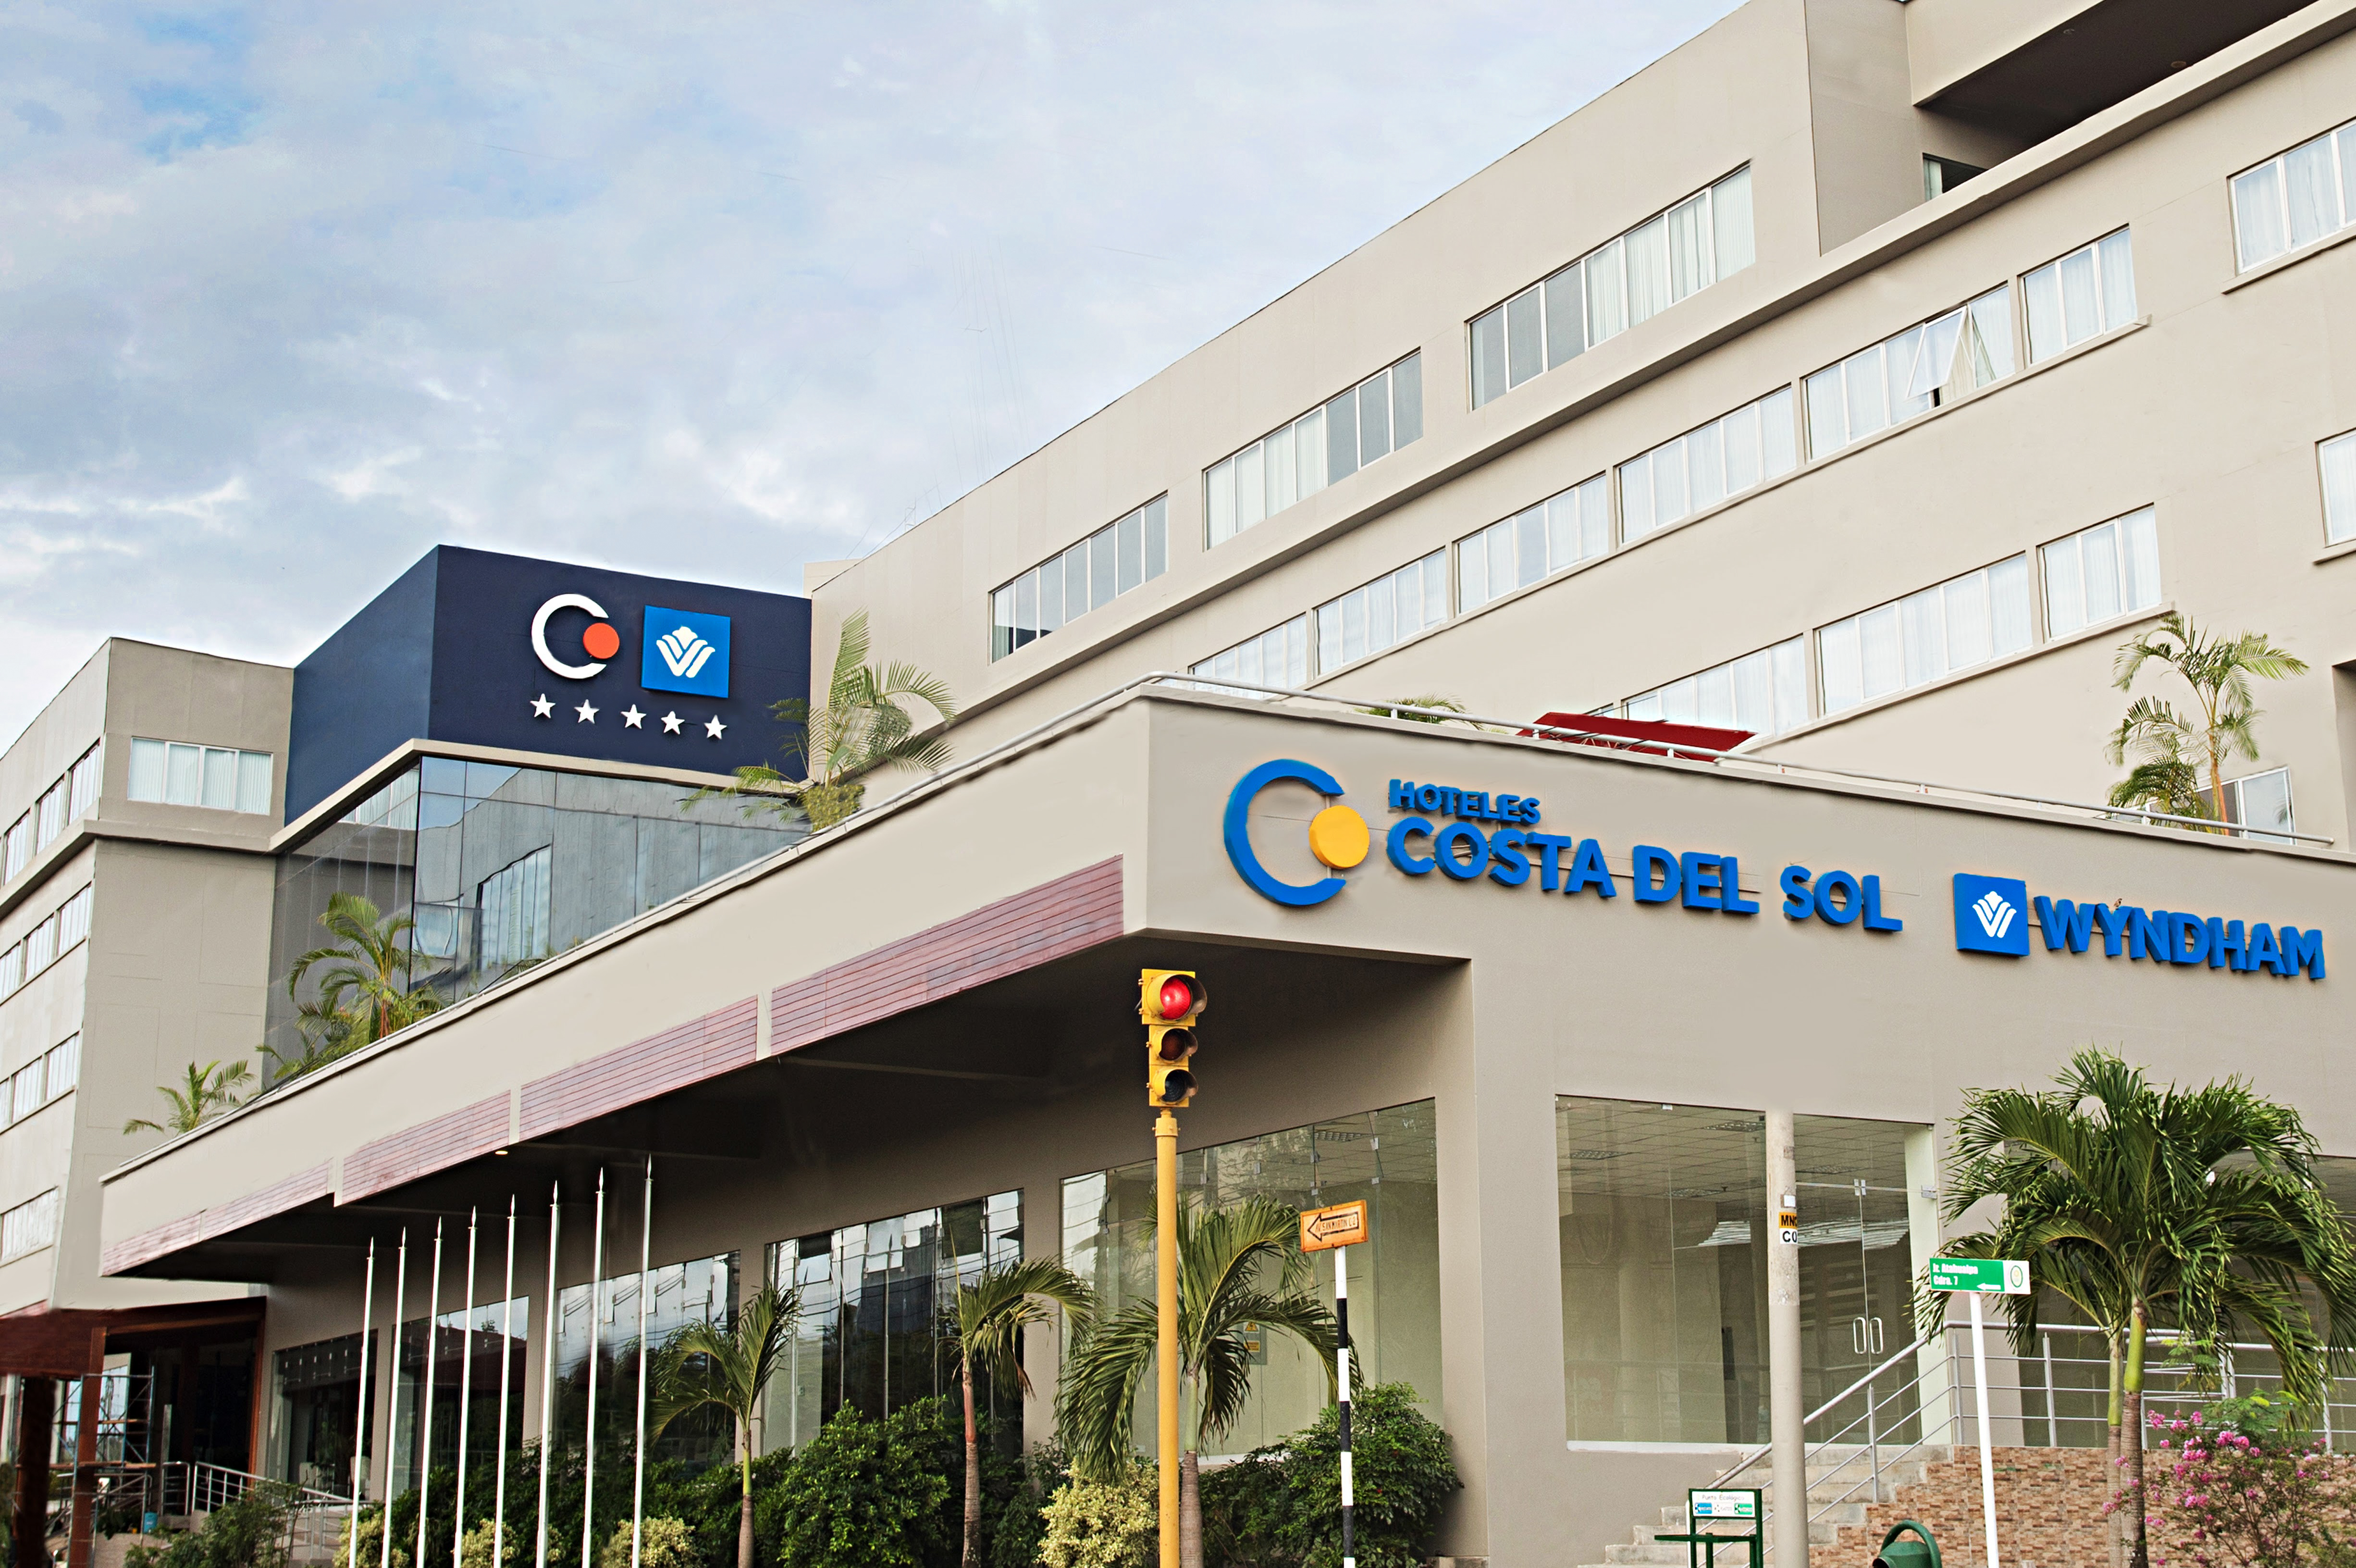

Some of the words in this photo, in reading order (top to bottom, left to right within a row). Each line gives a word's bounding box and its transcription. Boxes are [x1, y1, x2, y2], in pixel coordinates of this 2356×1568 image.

[1389, 779, 1541, 826] HOTELES
[1386, 816, 1616, 898] COSTA
[1633, 845, 1760, 914] DEL
[1780, 865, 1903, 932] SOL
[2033, 895, 2326, 980] WYNDHAM
[1941, 1263, 1978, 1275] Atahualpa
